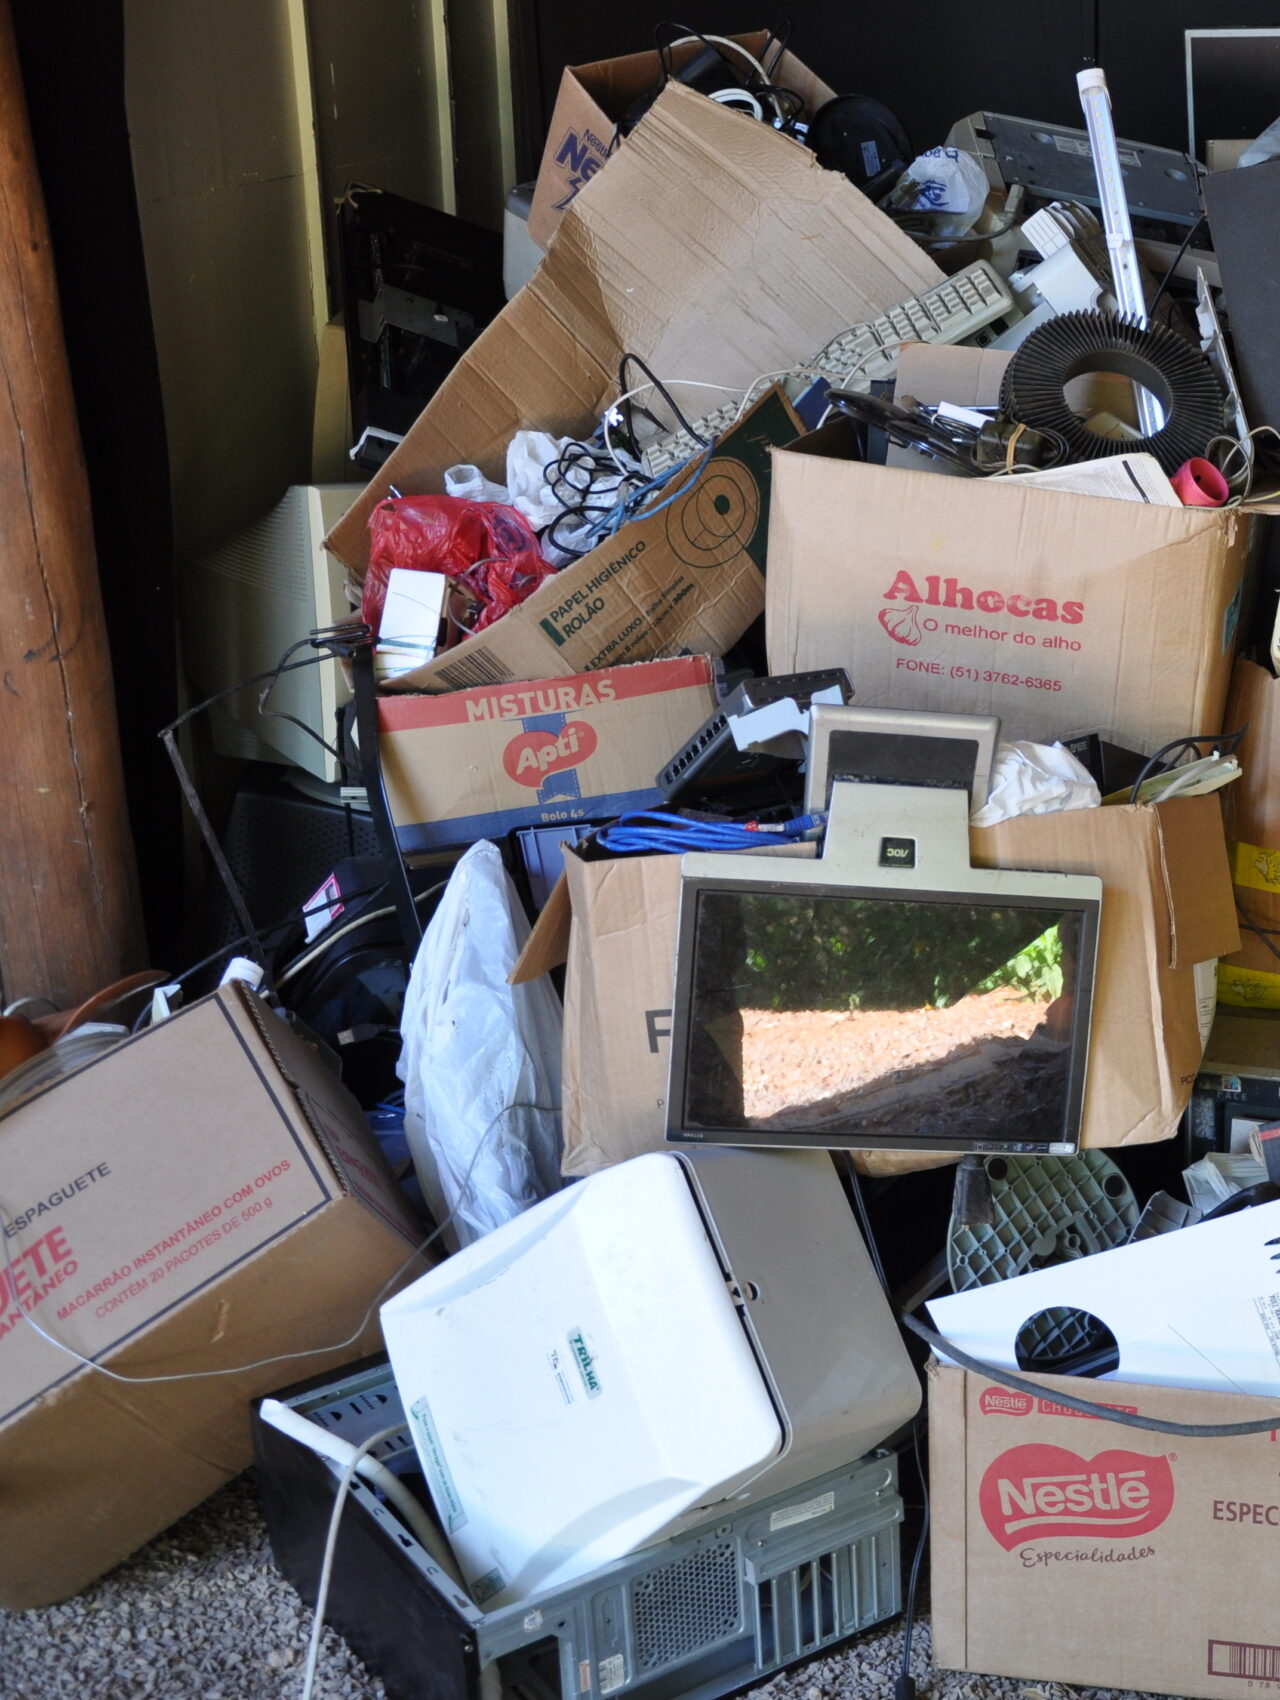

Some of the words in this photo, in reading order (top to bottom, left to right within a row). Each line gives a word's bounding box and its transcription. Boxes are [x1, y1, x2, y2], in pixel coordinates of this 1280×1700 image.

[549, 590, 588, 623] PAPEL
[585, 540, 646, 594] HIGIÊNICO
[883, 570, 1085, 625] Alhocas
[562, 596, 605, 638] ROLÃO
[923, 618, 938, 632] O
[945, 623, 1008, 642] melhor
[1013, 631, 1036, 646] do
[1042, 636, 1082, 651] alho
[591, 639, 618, 671] EXTRA
[617, 616, 642, 643] LUXO
[896, 658, 945, 675] FONE:
[950, 665, 979, 682] (51)
[983, 670, 1062, 691] 3762-6365
[465, 680, 616, 722] MISTURAS
[515, 728, 579, 775] Apti
[541, 811, 567, 822] Bolo
[570, 808, 584, 818] 4s
[886, 847, 909, 858] AOC
[3, 1162, 112, 1239] ESPAGUETE
[56, 1264, 132, 1321] MACARRÃO
[132, 1205, 223, 1269] INSTANTÂNEO
[223, 1184, 254, 1210] COM
[254, 1159, 291, 1189] OVOS
[95, 1278, 150, 1320] CONTÉM
[149, 1268, 165, 1284] 20
[165, 1229, 222, 1274] PACOTES
[222, 1218, 241, 1235] DE
[242, 1200, 264, 1221] 500
[264, 1197, 273, 1209] g
[572, 1333, 599, 1393] TRILHA
[985, 1394, 1027, 1410] Nestlé
[998, 1470, 1150, 1516] Nestlé
[1020, 1545, 1156, 1568] Especialidades
